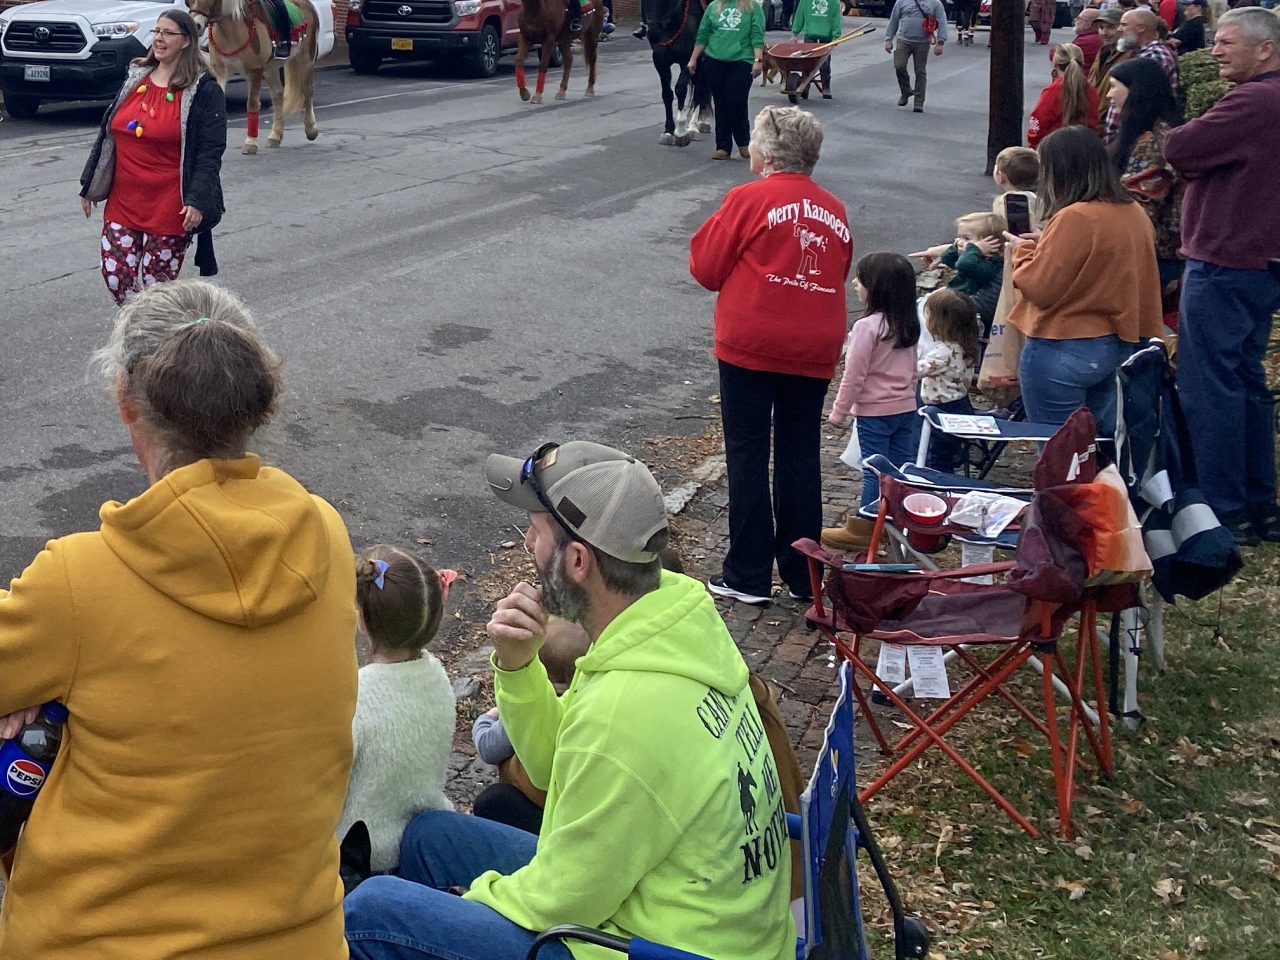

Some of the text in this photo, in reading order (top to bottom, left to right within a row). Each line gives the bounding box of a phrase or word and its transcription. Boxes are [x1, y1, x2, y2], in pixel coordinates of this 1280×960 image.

[767, 198, 850, 244] Merry Kazooers
[765, 273, 781, 283] The
[800, 280, 809, 290] Of
[735, 702, 765, 765] TELL
[9, 765, 43, 786] PEPSI
